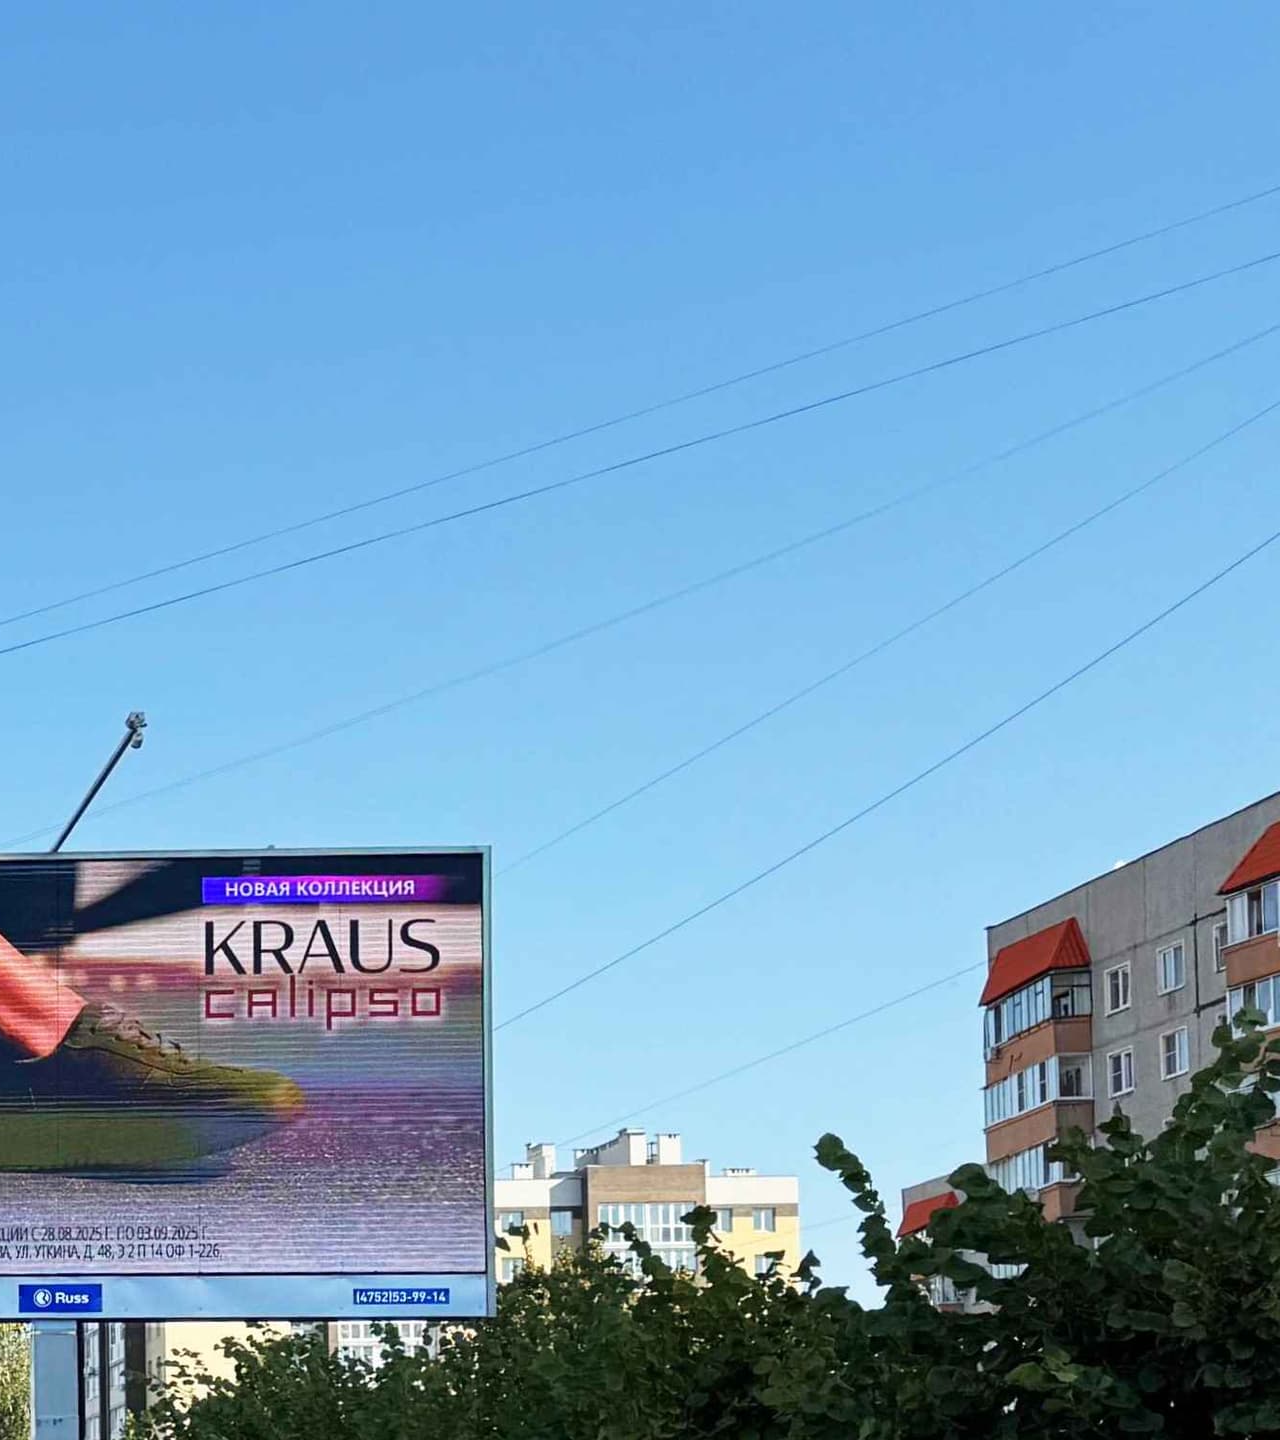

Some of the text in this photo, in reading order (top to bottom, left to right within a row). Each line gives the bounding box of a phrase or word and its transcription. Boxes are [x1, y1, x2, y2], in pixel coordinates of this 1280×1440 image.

[225, 880, 415, 898] НОВАЯ КОЛЛЕКЦИЯ
[204, 918, 441, 976] KRAUS
[150, 1243, 163, 1257] 14
[166, 1243, 185, 1259] ОФ
[55, 1292, 90, 1304] Russ
[356, 1290, 446, 1304] (4752)53-99-14
